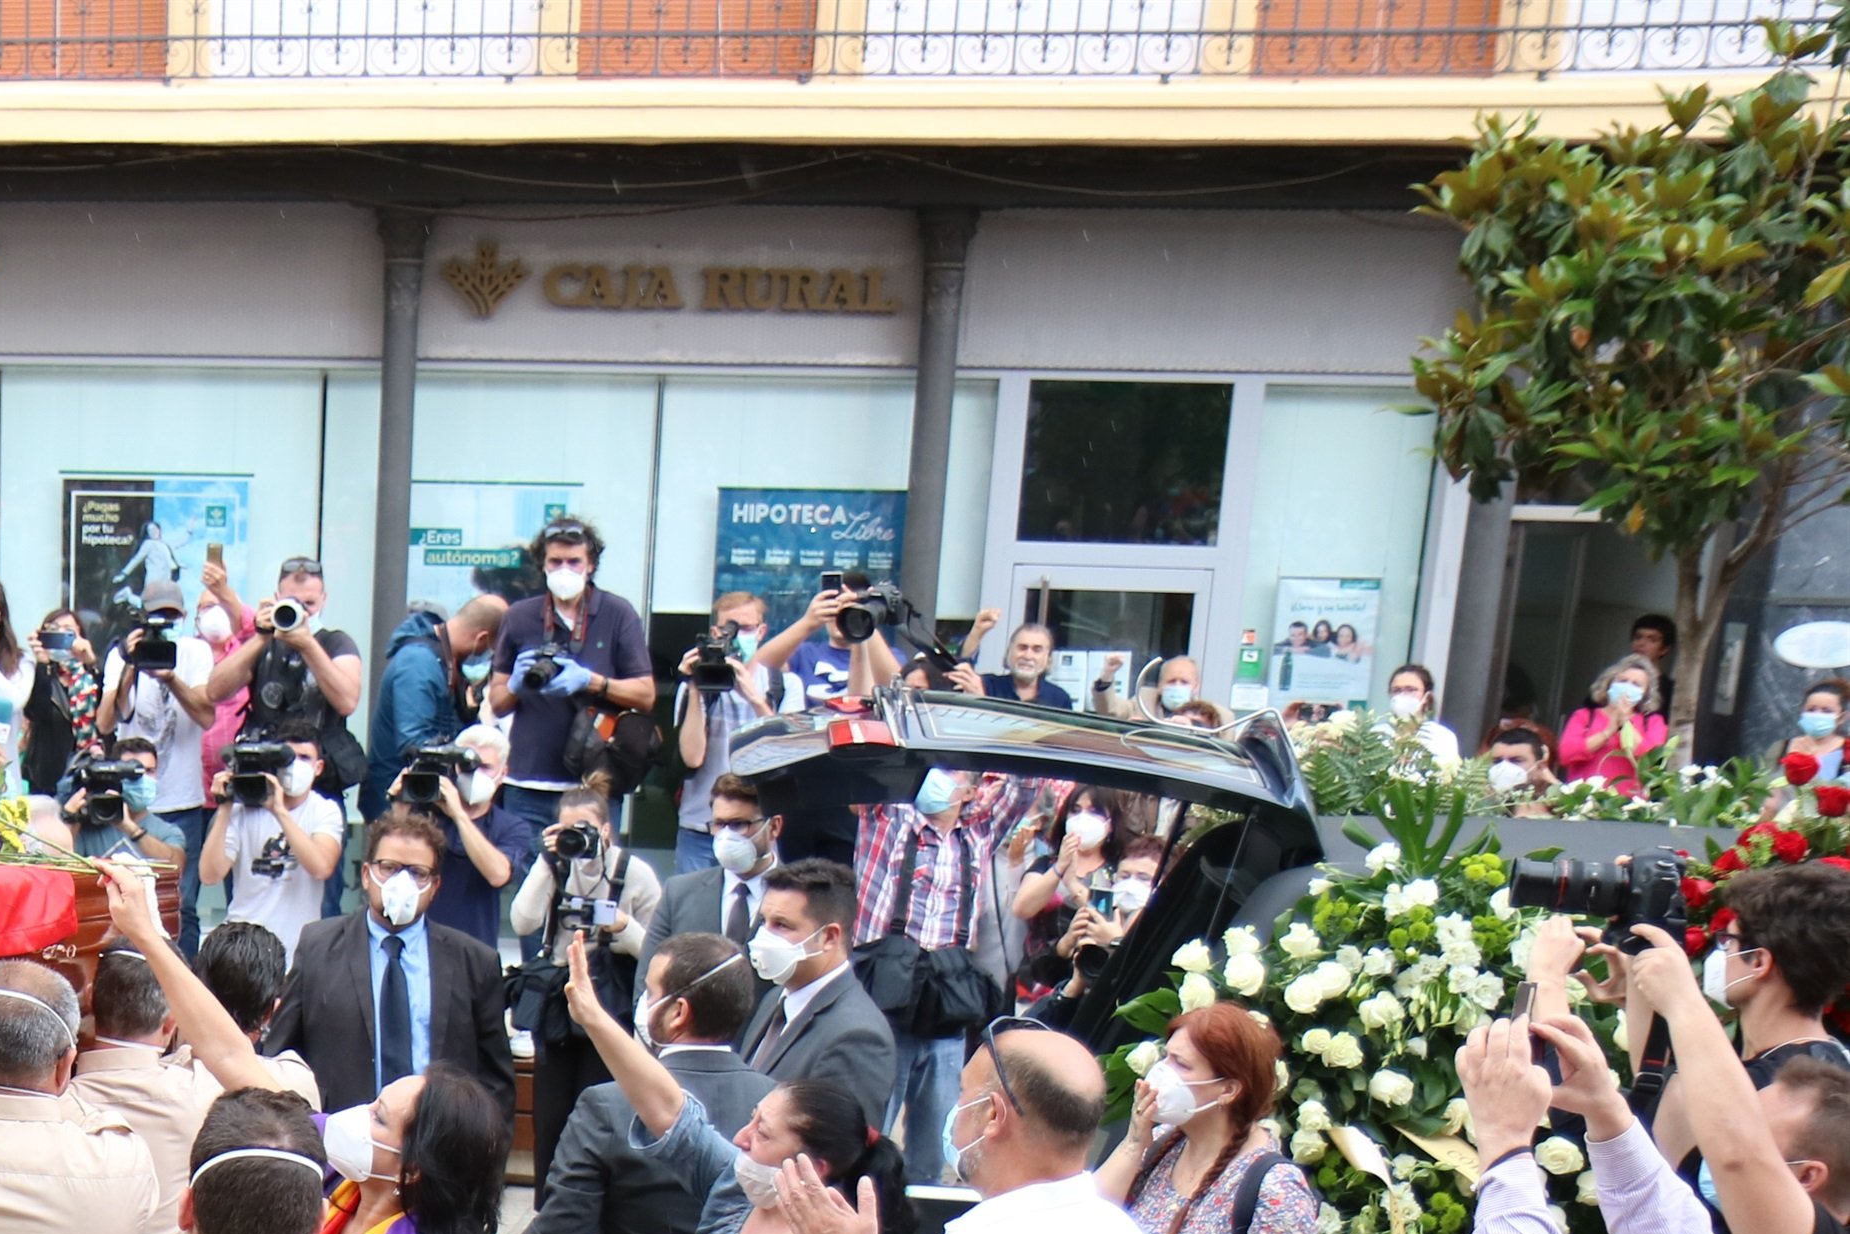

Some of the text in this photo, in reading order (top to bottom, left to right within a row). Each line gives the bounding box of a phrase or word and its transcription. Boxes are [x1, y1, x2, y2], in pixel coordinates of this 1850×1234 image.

[543, 261, 902, 313] CAJA RURAL
[82, 500, 121, 514] ¿Pagas
[731, 502, 849, 526] HIPOTECA
[82, 513, 120, 523] mucho
[81, 524, 114, 535] por tu
[831, 511, 896, 542] Libre
[81, 533, 134, 547] hipoteca?
[419, 530, 461, 545] ¿Eres
